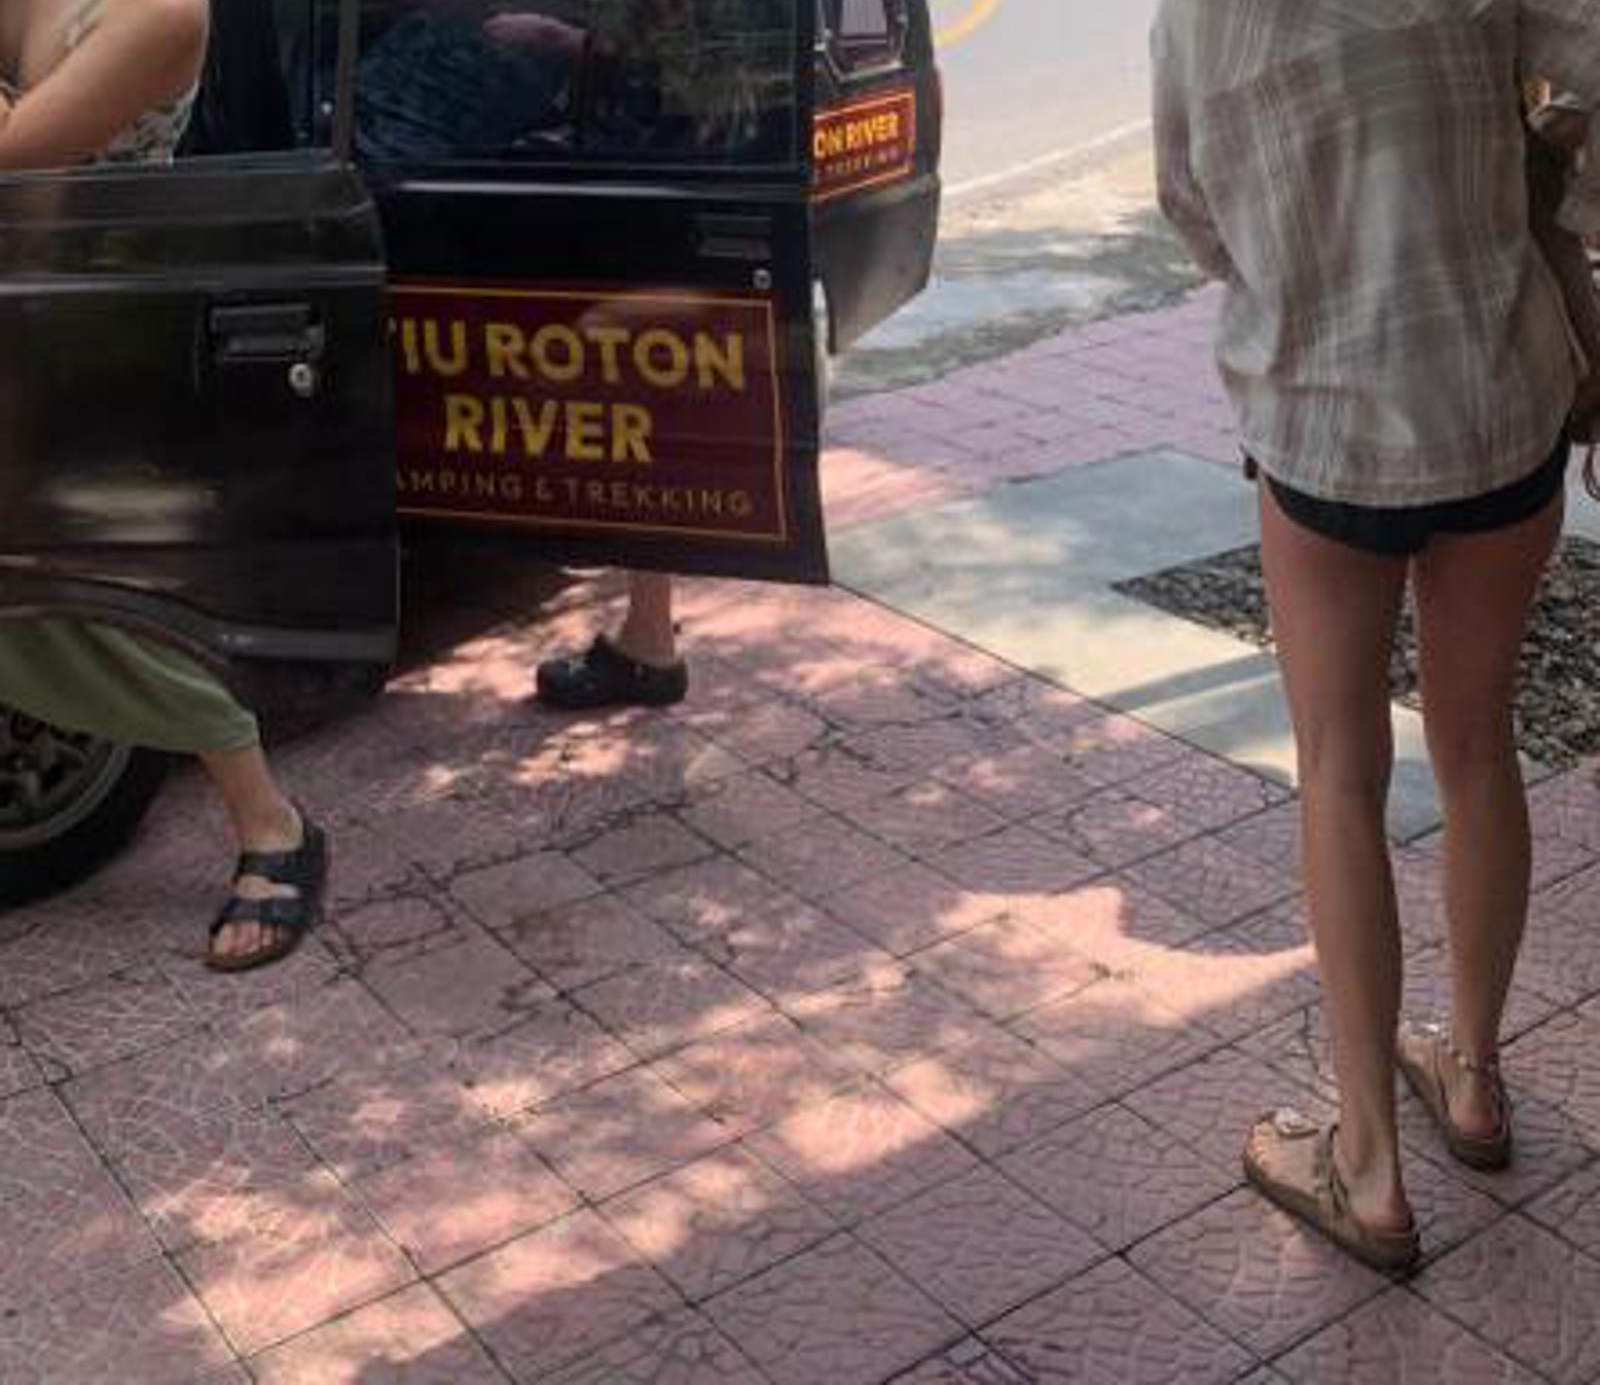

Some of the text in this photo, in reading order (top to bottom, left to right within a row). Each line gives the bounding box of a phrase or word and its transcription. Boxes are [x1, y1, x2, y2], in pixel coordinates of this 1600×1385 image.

[846, 112, 899, 149] RIVER
[388, 316, 746, 391] IU ROTON
[444, 394, 654, 464] RIVER
[563, 479, 752, 515] TREKKING
